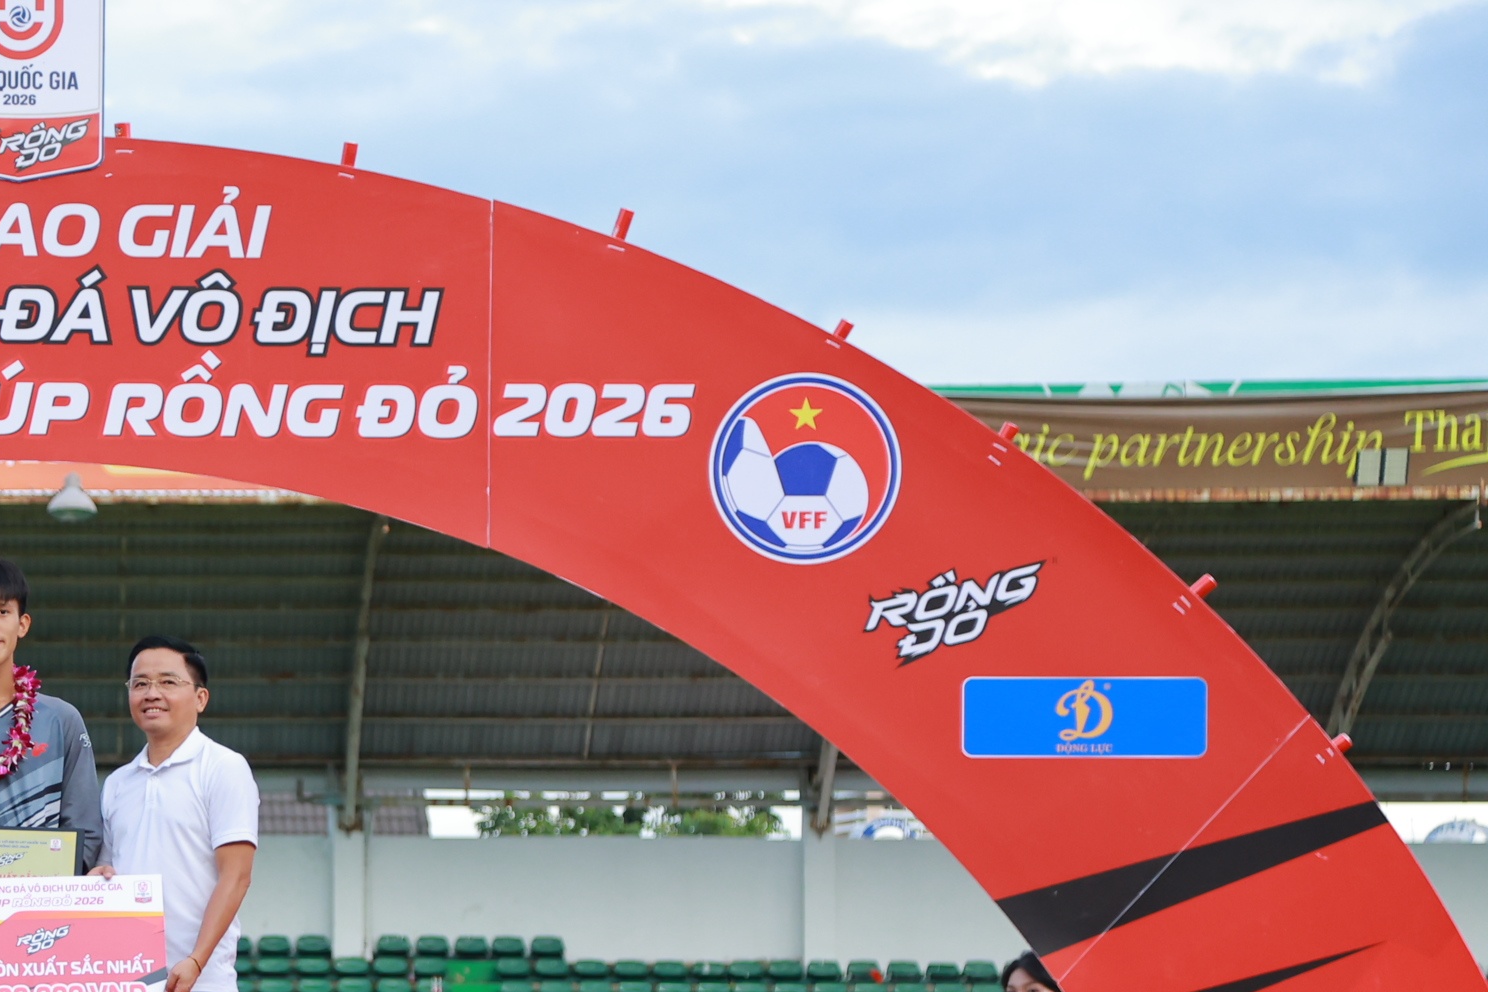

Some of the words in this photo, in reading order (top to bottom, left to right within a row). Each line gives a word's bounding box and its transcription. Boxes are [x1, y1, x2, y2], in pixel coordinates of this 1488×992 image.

[49, 71, 79, 90] GIA
[3, 94, 37, 106] 2026
[117, 186, 272, 259] GIẢI
[128, 269, 244, 346] VÔ
[253, 286, 444, 358] ĐỊCH
[102, 350, 344, 438] RỒNG
[355, 365, 477, 439] ĐỎ
[492, 382, 695, 438] 2026
[1083, 412, 1383, 480] partnership
[1405, 409, 1488, 453] Tha
[782, 511, 827, 530] VFF
[864, 562, 1043, 632] RỒNG
[897, 600, 989, 659] ĐỎ
[13, 884, 26, 893] ĐÁ
[28, 884, 41, 893] VÔ
[42, 884, 62, 894] ĐỊCH
[65, 884, 79, 892] U17
[80, 881, 106, 892] QUỐC
[107, 883, 123, 891] GIA
[12, 892, 51, 908] RỒNG
[51, 894, 73, 907] ĐỎ
[74, 896, 104, 906] 2026
[16, 925, 71, 947] RỒNG
[21, 955, 68, 977] XUẤT
[71, 954, 104, 975] SẮC
[106, 953, 155, 974] NHẤT
